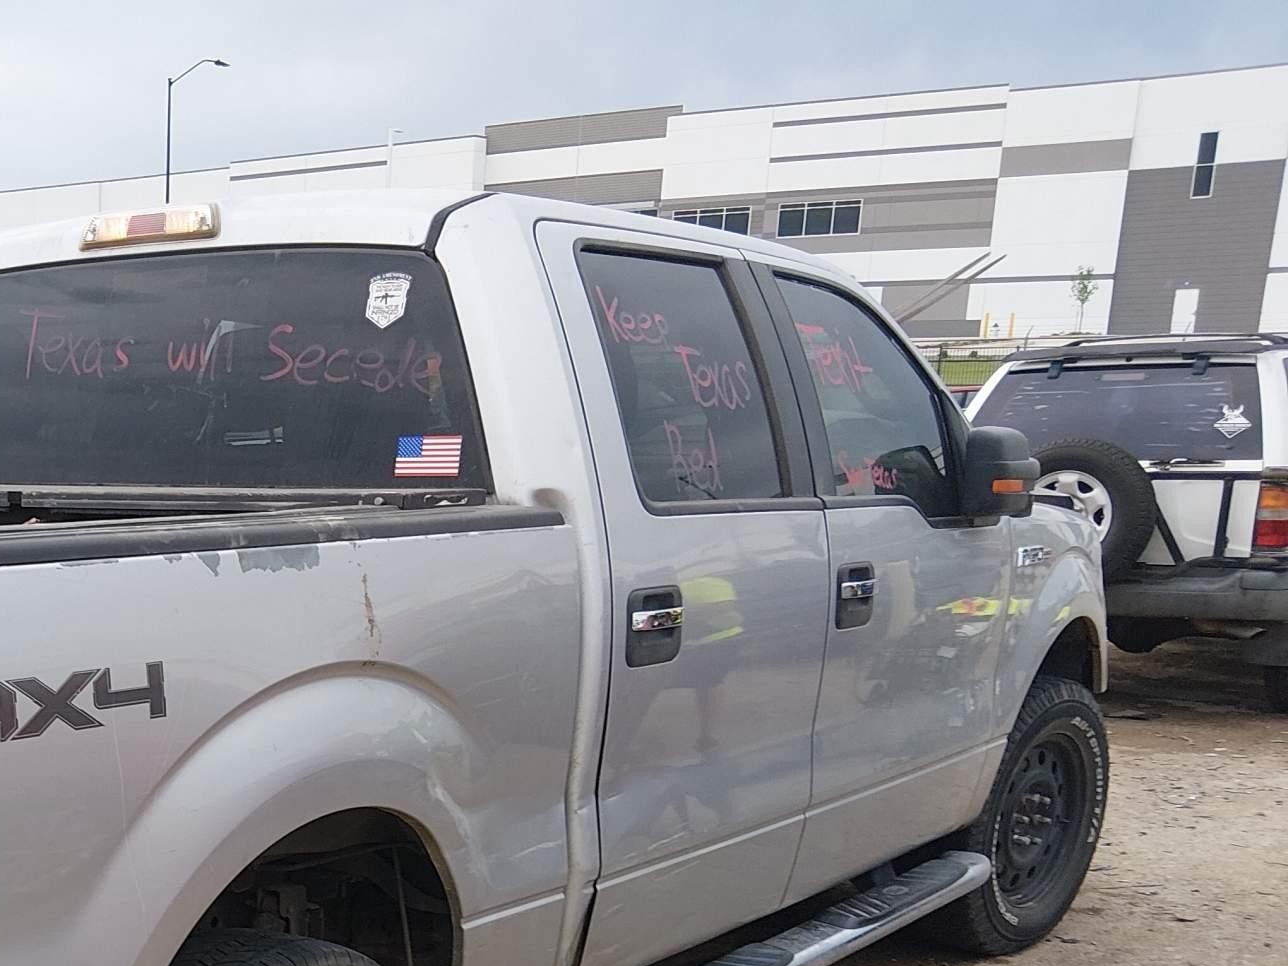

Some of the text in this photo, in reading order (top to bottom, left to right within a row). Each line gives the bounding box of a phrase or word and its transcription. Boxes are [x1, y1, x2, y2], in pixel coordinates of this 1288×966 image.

[20, 308, 135, 380] Texas
[596, 286, 668, 344] Keep
[674, 344, 752, 410] Texas
